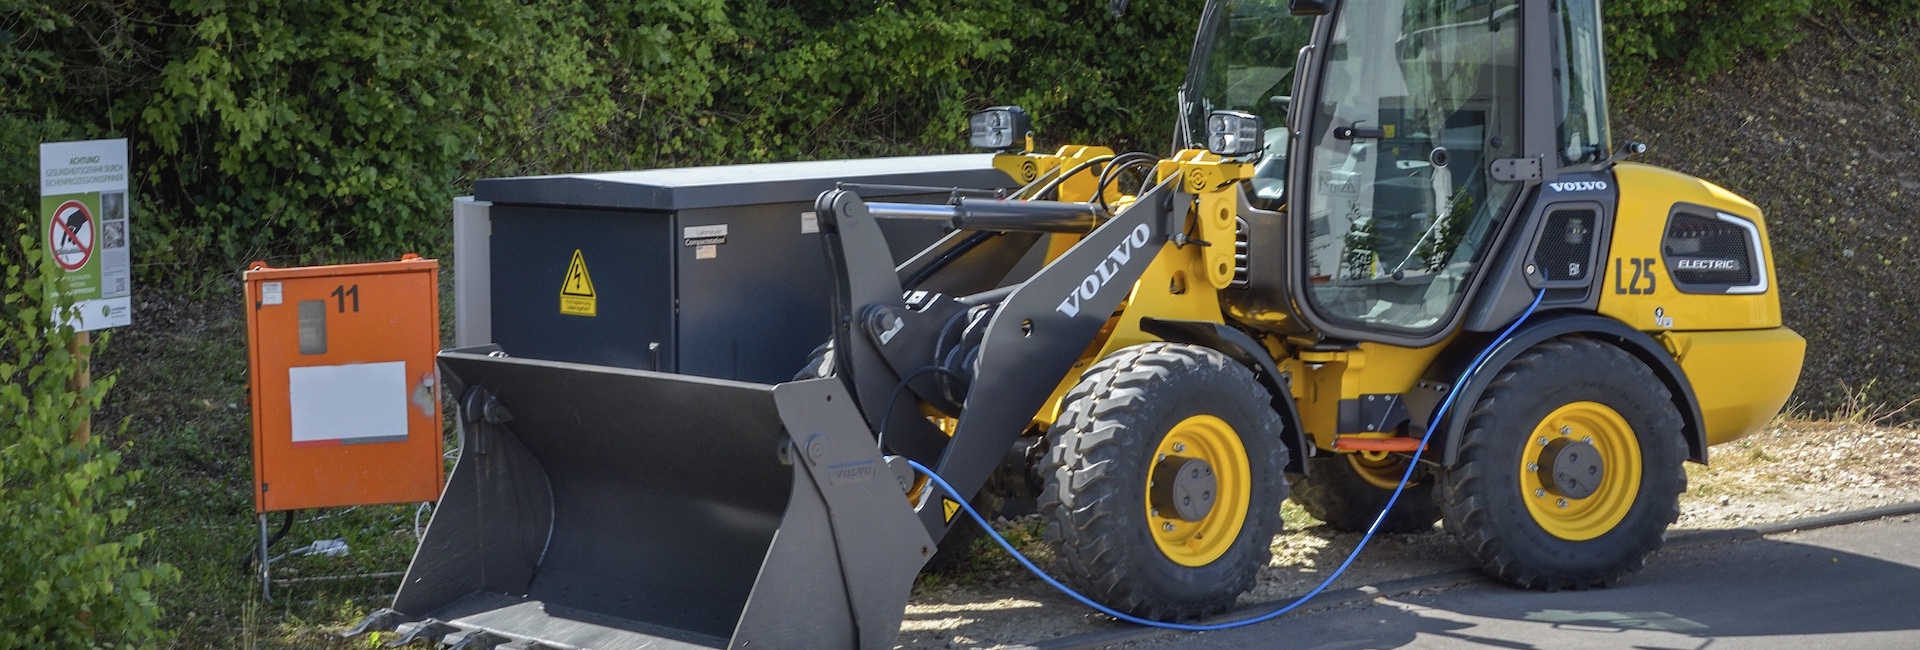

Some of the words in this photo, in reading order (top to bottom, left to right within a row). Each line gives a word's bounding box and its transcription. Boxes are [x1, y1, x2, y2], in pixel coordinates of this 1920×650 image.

[104, 164, 124, 173] DURCH
[1548, 180, 1608, 192] VOLVO
[1056, 223, 1150, 319] VOLVO
[1677, 259, 1734, 270] ELECTRIC
[1615, 257, 1656, 295] L25
[331, 284, 359, 313] 11
[835, 465, 874, 479] VOLVO
